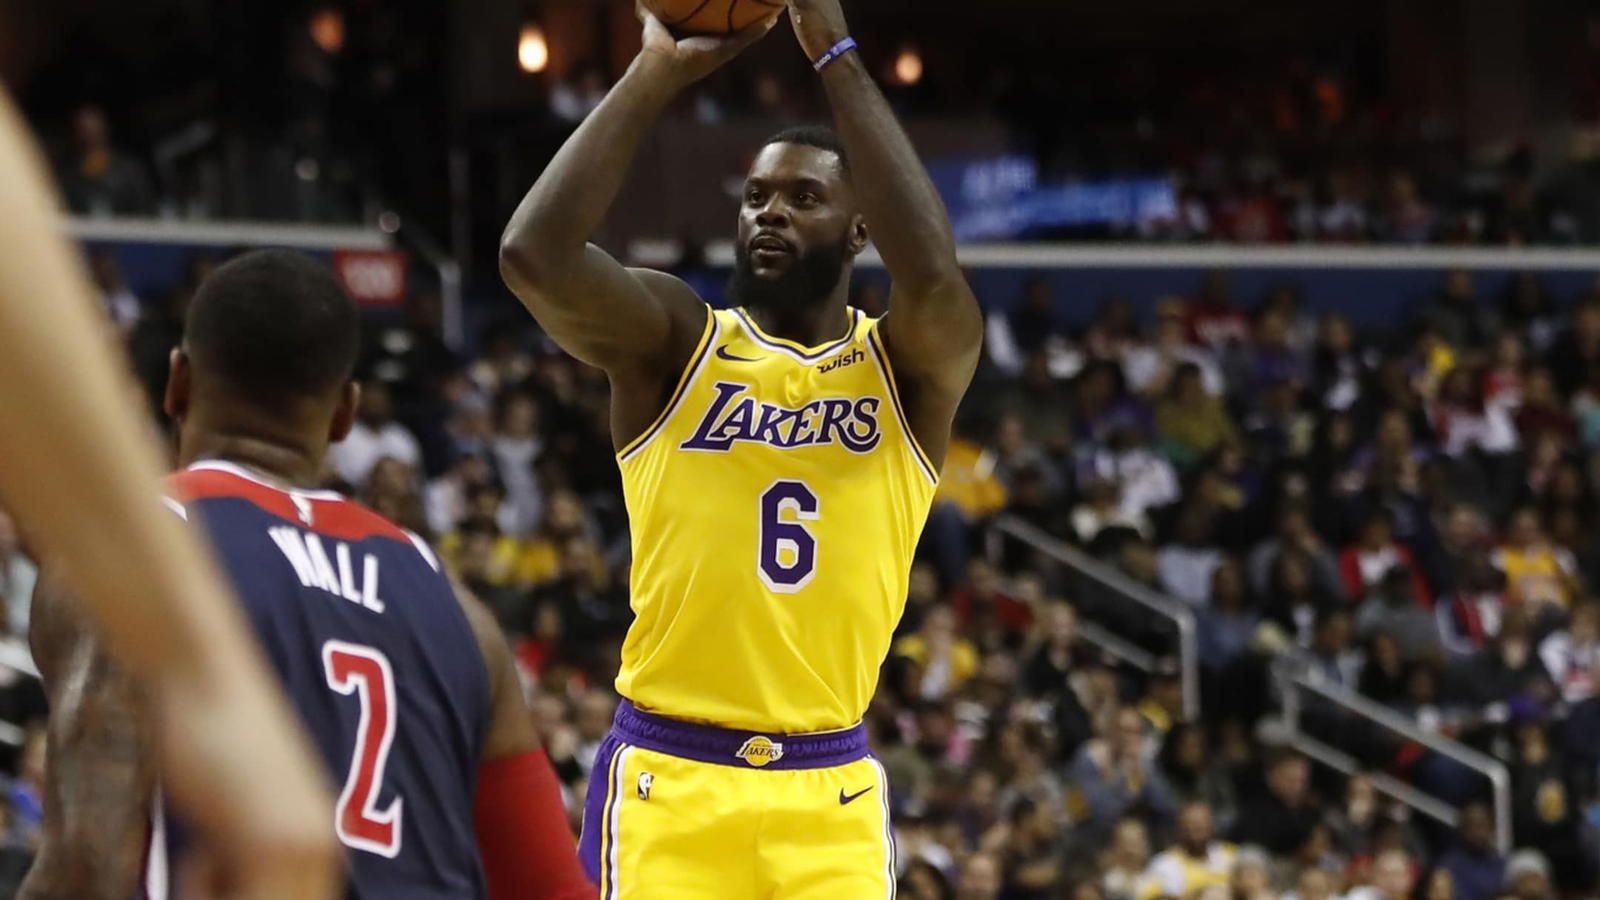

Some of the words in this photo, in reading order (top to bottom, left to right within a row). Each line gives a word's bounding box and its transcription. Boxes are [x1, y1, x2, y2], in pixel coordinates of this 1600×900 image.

[816, 348, 865, 374] wish
[679, 381, 881, 455] LAKERS
[266, 525, 386, 614] WALL
[756, 479, 820, 595] 6
[322, 639, 402, 859] 2
